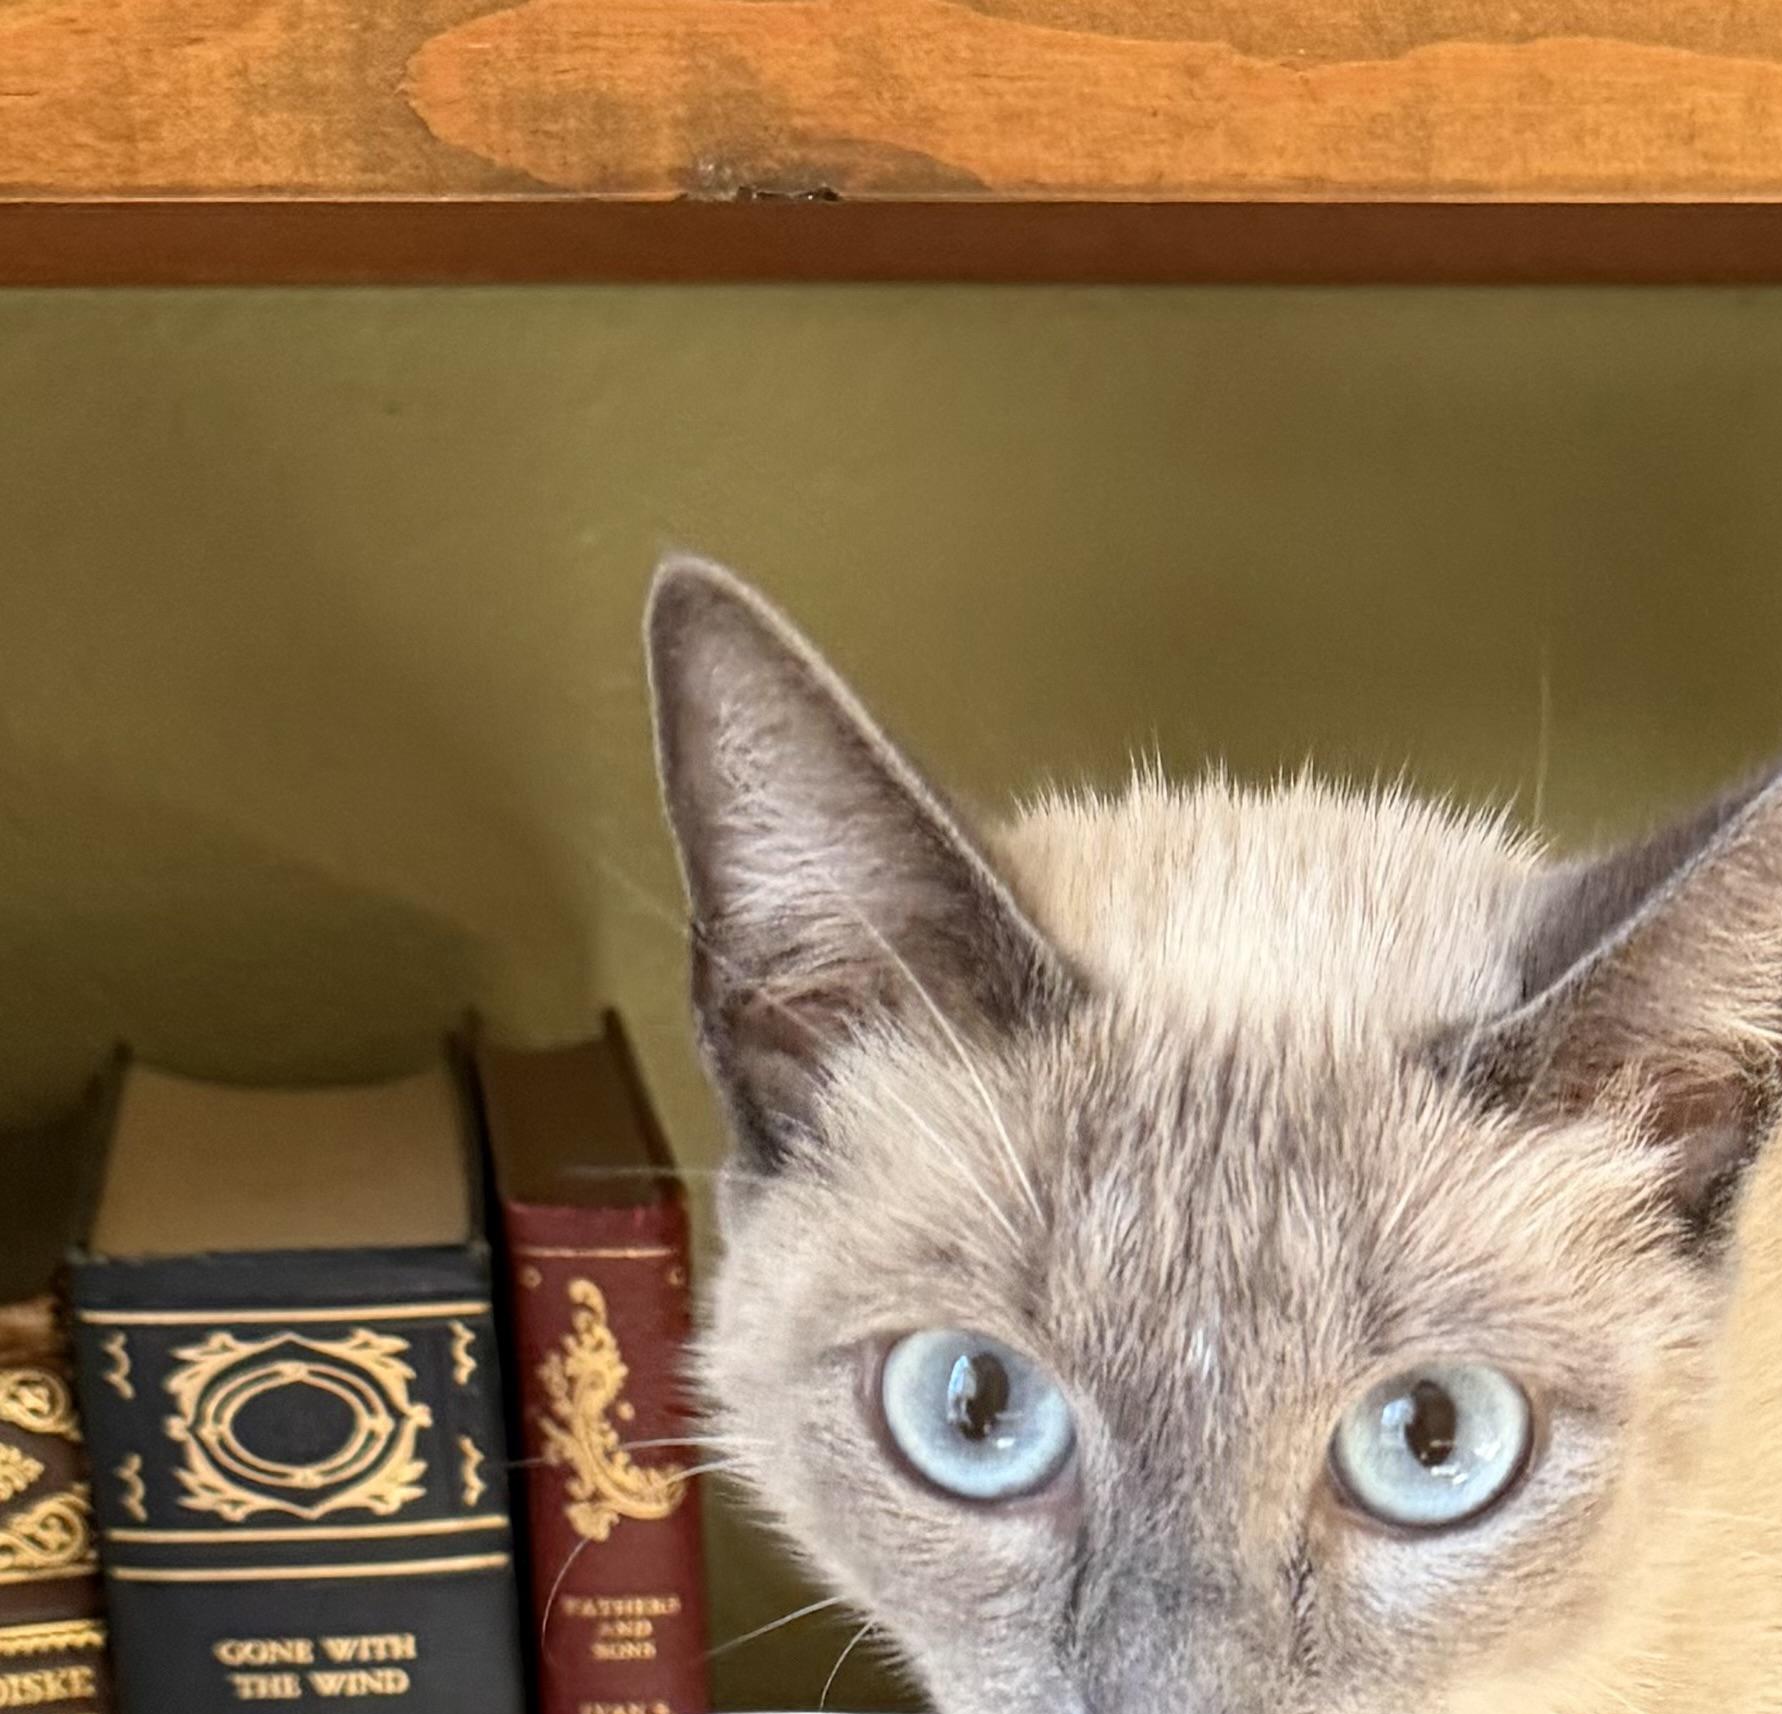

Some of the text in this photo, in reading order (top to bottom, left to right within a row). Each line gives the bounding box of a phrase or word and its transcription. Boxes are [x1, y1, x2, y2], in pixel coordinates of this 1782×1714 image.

[600, 1619, 653, 1637] AND
[213, 1632, 417, 1666] GONE WITH
[228, 1667, 410, 1699] THE WIND
